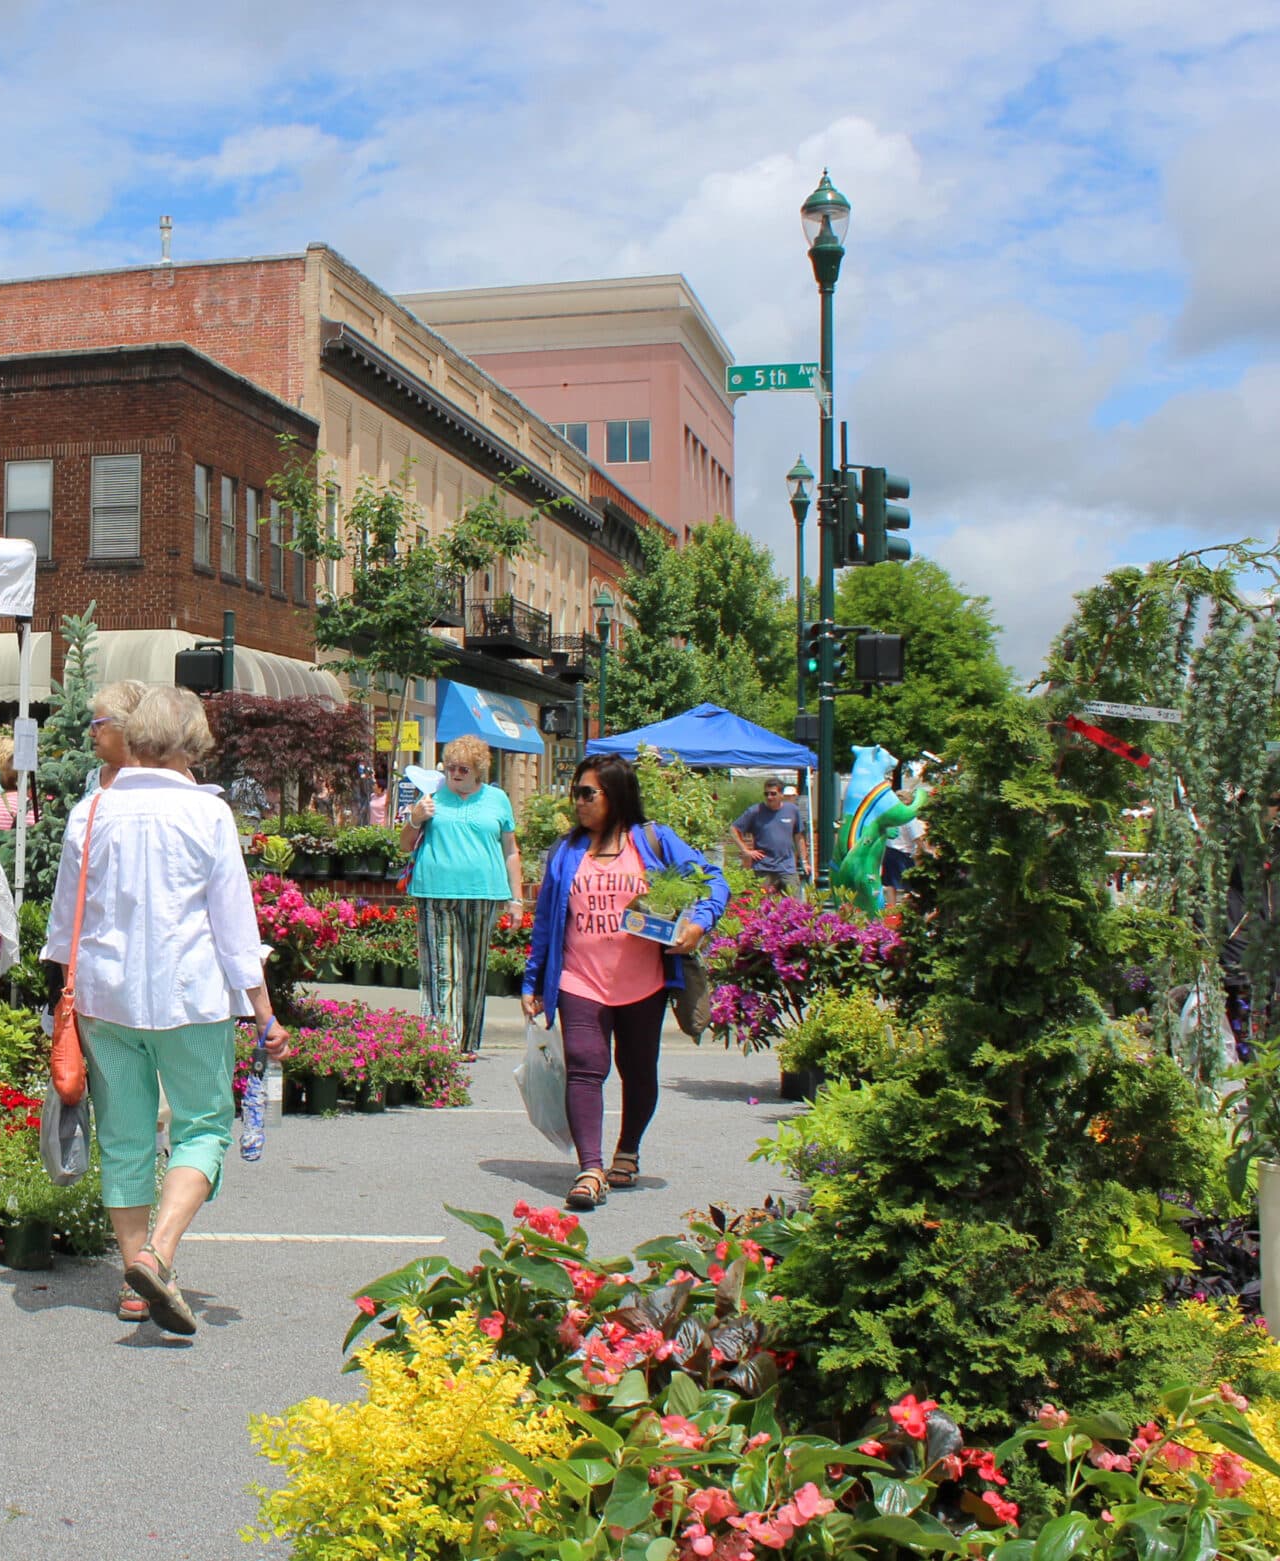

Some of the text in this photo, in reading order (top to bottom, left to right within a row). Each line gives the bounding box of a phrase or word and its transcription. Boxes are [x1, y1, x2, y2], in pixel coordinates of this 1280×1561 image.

[754, 368, 787, 387] 5th
[569, 872, 647, 897] NYTHING
[588, 894, 616, 911] BUT
[575, 912, 622, 935] CARD
